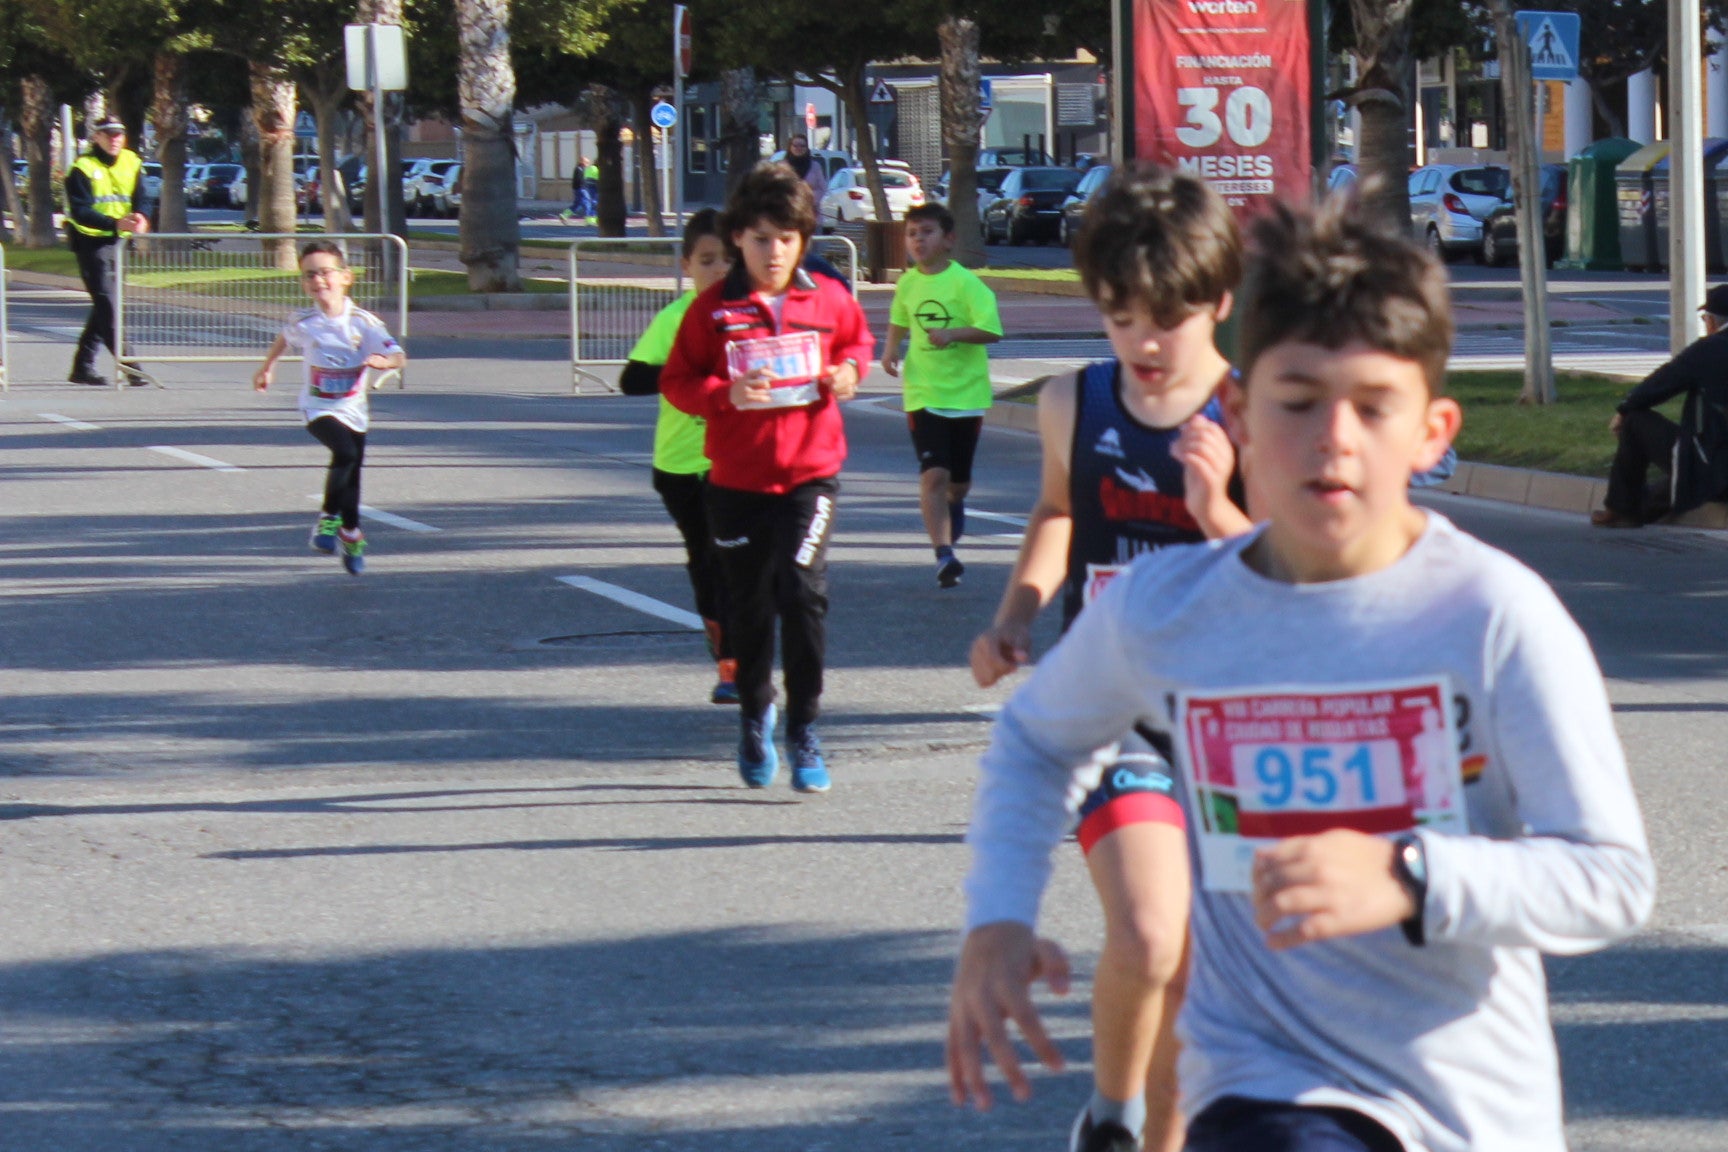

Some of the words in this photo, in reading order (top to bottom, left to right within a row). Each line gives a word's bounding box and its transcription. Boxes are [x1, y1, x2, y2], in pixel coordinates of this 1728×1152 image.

[1187, 0, 1258, 14] worten
[1176, 52, 1272, 68] FINANCIACIÓN
[1203, 76, 1244, 85] HASTA
[1175, 86, 1273, 147] 30
[1178, 155, 1274, 178] MESES
[1254, 743, 1377, 808] 951
